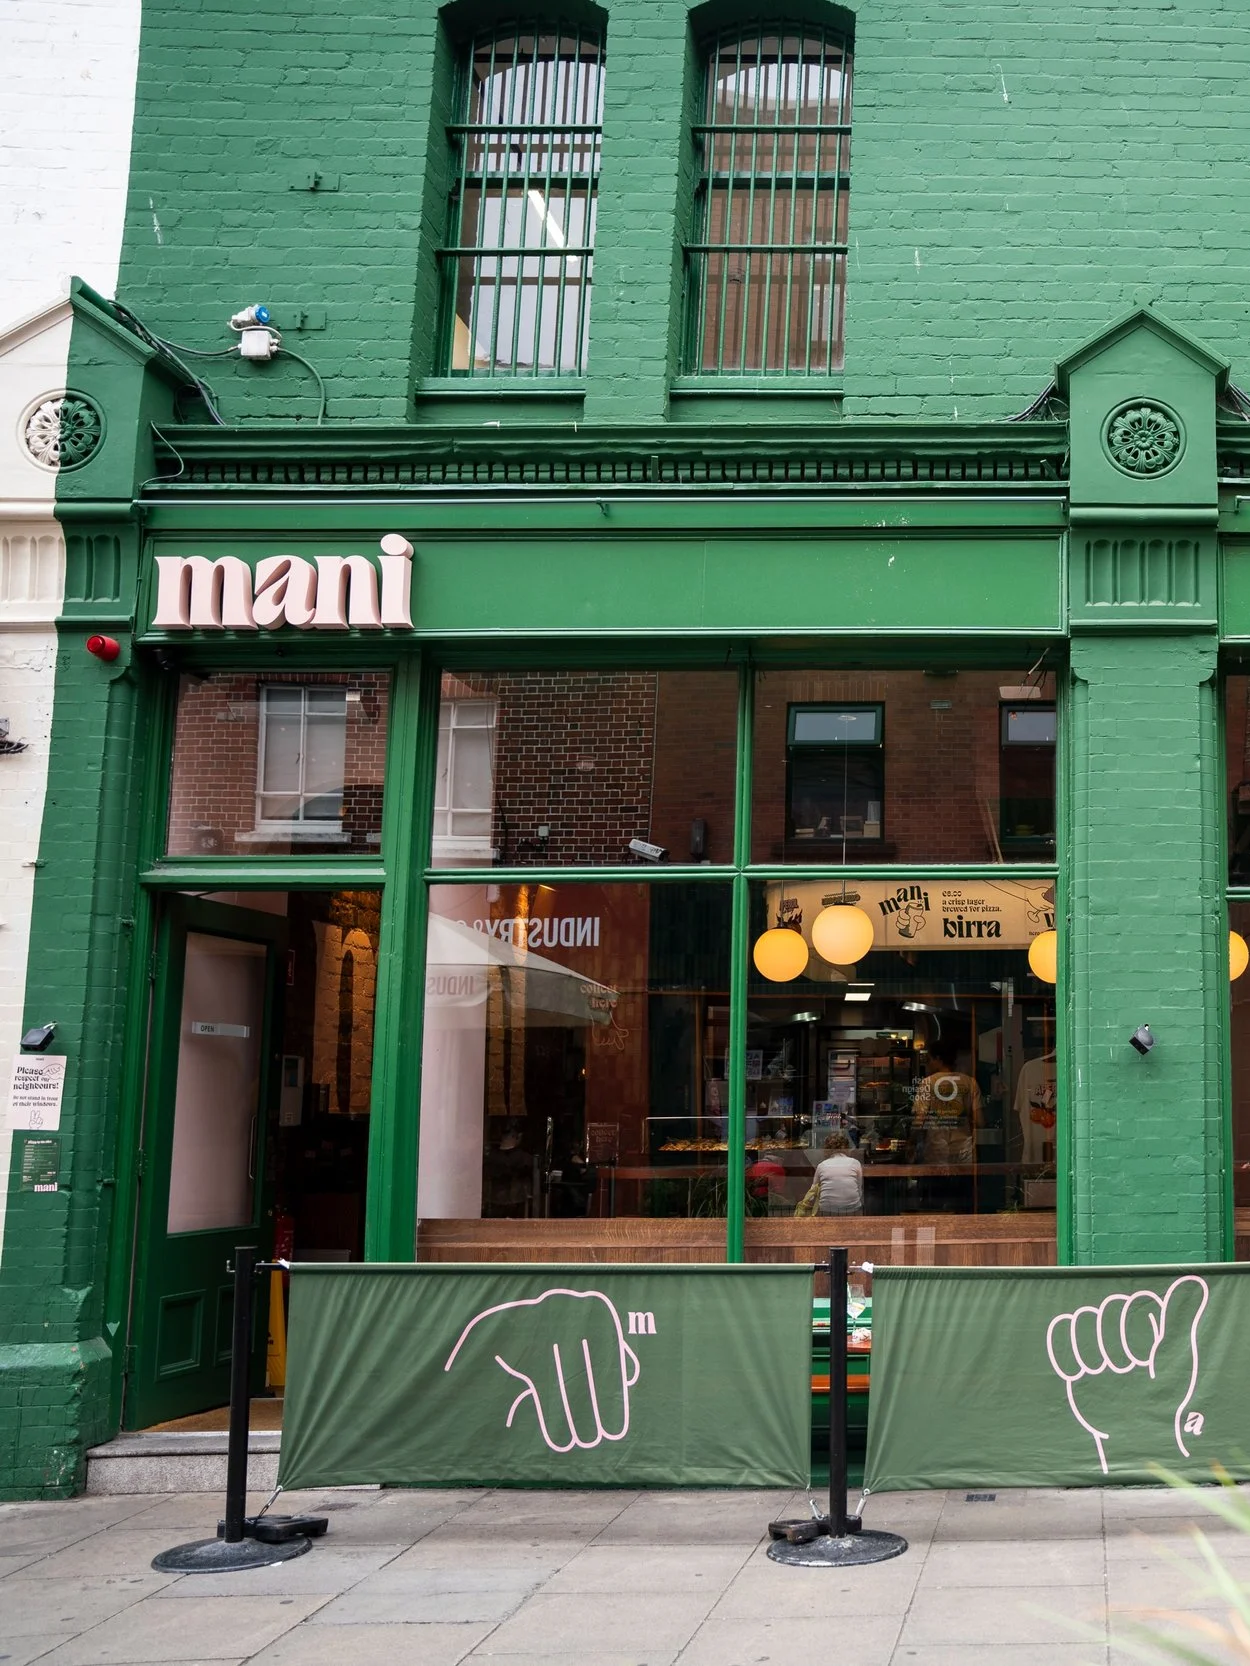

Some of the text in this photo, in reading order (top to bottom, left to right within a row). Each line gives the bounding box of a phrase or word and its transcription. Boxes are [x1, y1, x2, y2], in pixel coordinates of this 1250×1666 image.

[152, 533, 415, 631] mani
[878, 885, 931, 916] mani
[966, 898, 985, 907] lager
[943, 915, 1002, 938] birra
[200, 1025, 215, 1033] OPEN
[17, 1066, 44, 1075] Please
[13, 1082, 59, 1090] neighbours!
[34, 1182, 58, 1192] mani
[627, 1310, 657, 1335] m
[1183, 1410, 1205, 1436] a
